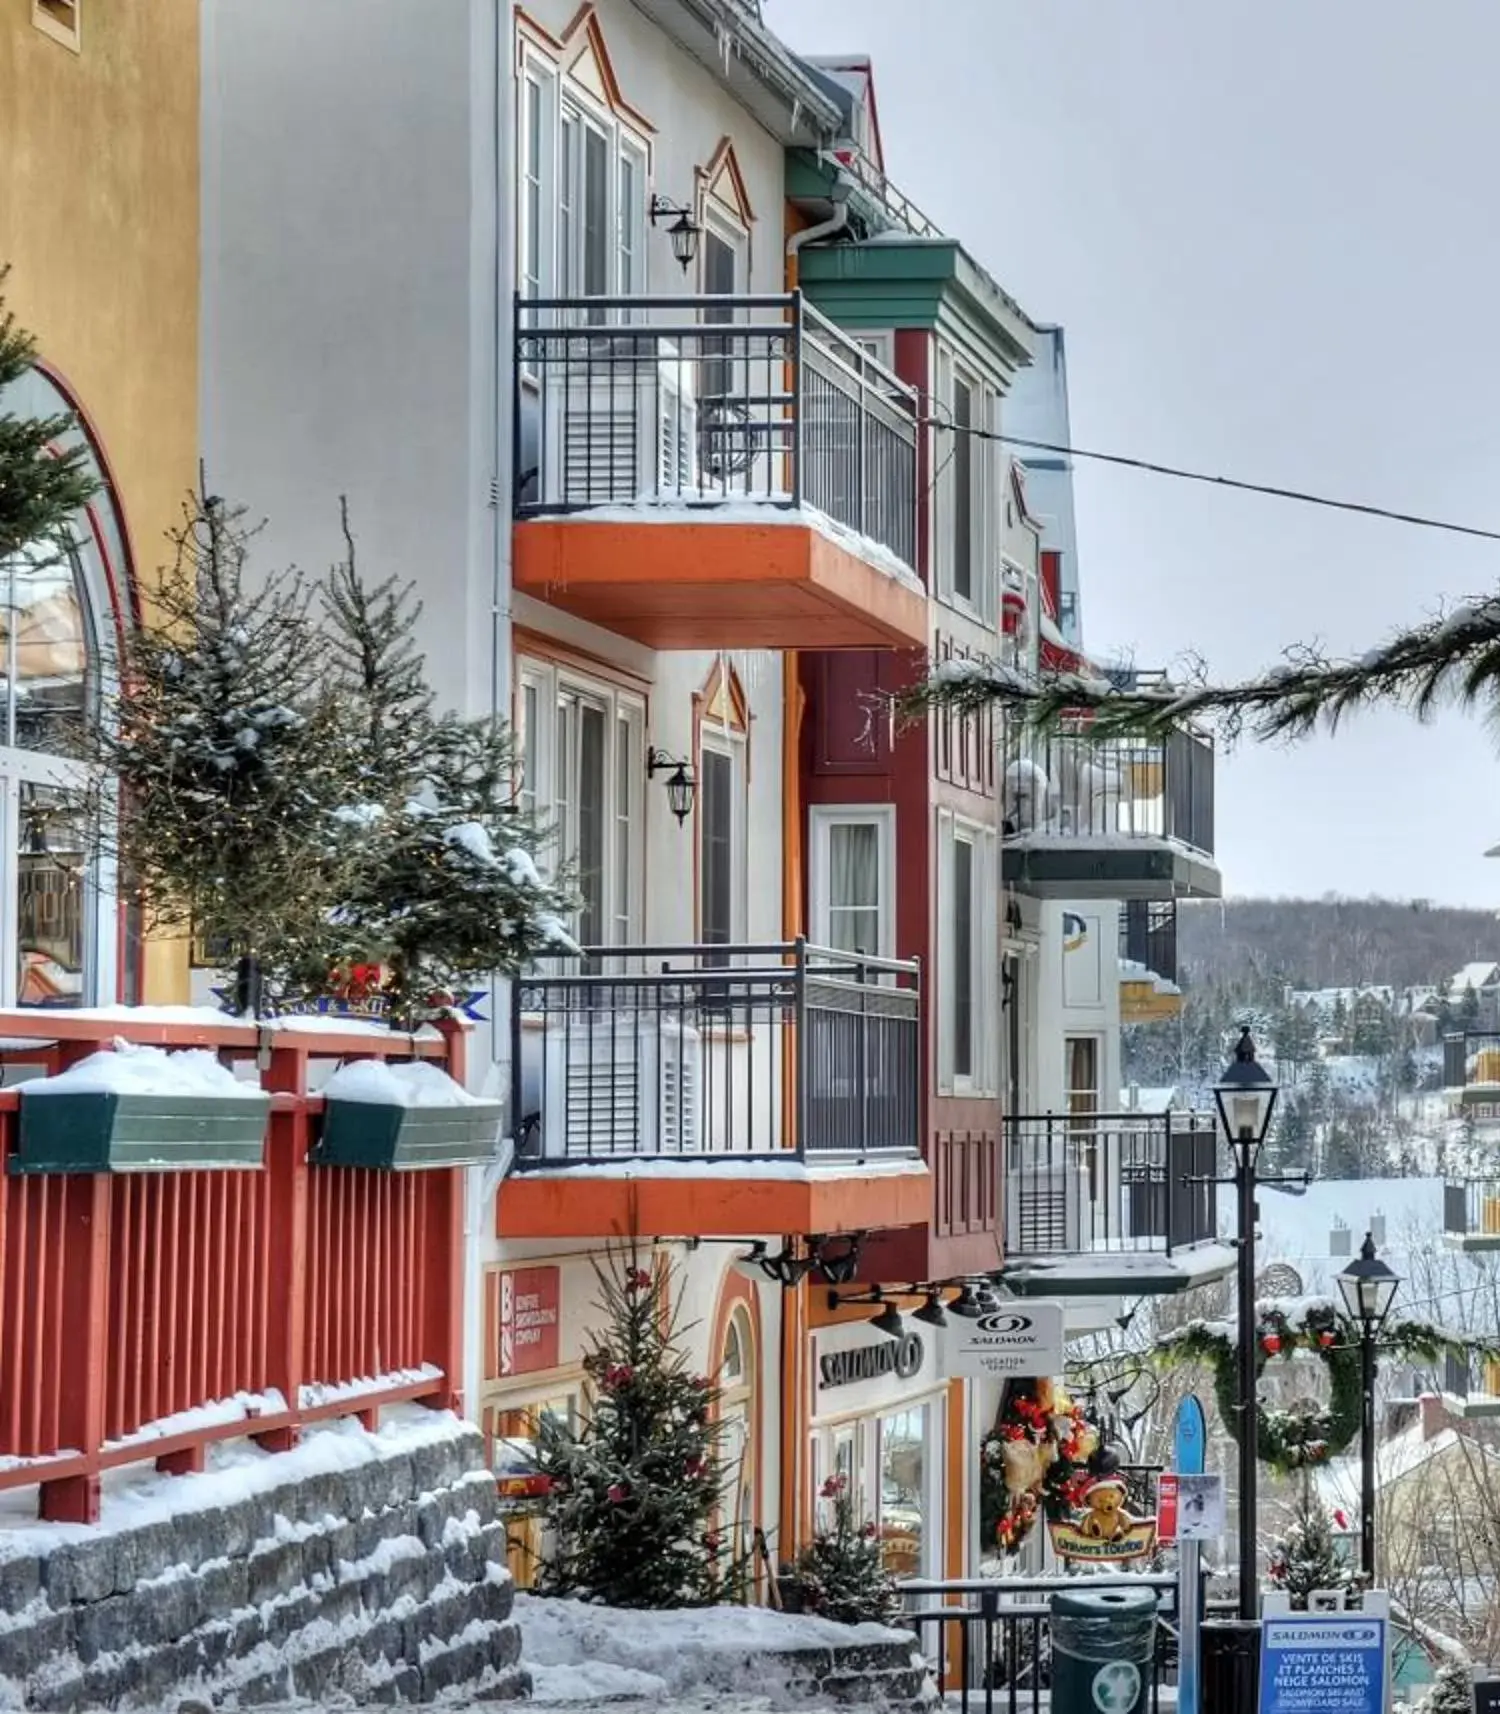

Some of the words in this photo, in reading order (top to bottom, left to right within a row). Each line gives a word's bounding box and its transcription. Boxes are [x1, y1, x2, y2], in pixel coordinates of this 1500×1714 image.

[968, 1336, 1038, 1344] SALOMON
[819, 1339, 897, 1390] SALOMON
[1271, 1631, 1341, 1641] SALOMON
[1281, 1653, 1319, 1664] VENTE
[1322, 1653, 1335, 1663] DE
[1339, 1652, 1365, 1663] SKIS
[1279, 1664, 1293, 1675] ET
[1295, 1663, 1355, 1675] PLANCHES
[1273, 1676, 1309, 1687] NEIGE
[1311, 1675, 1370, 1686] SALOMON
